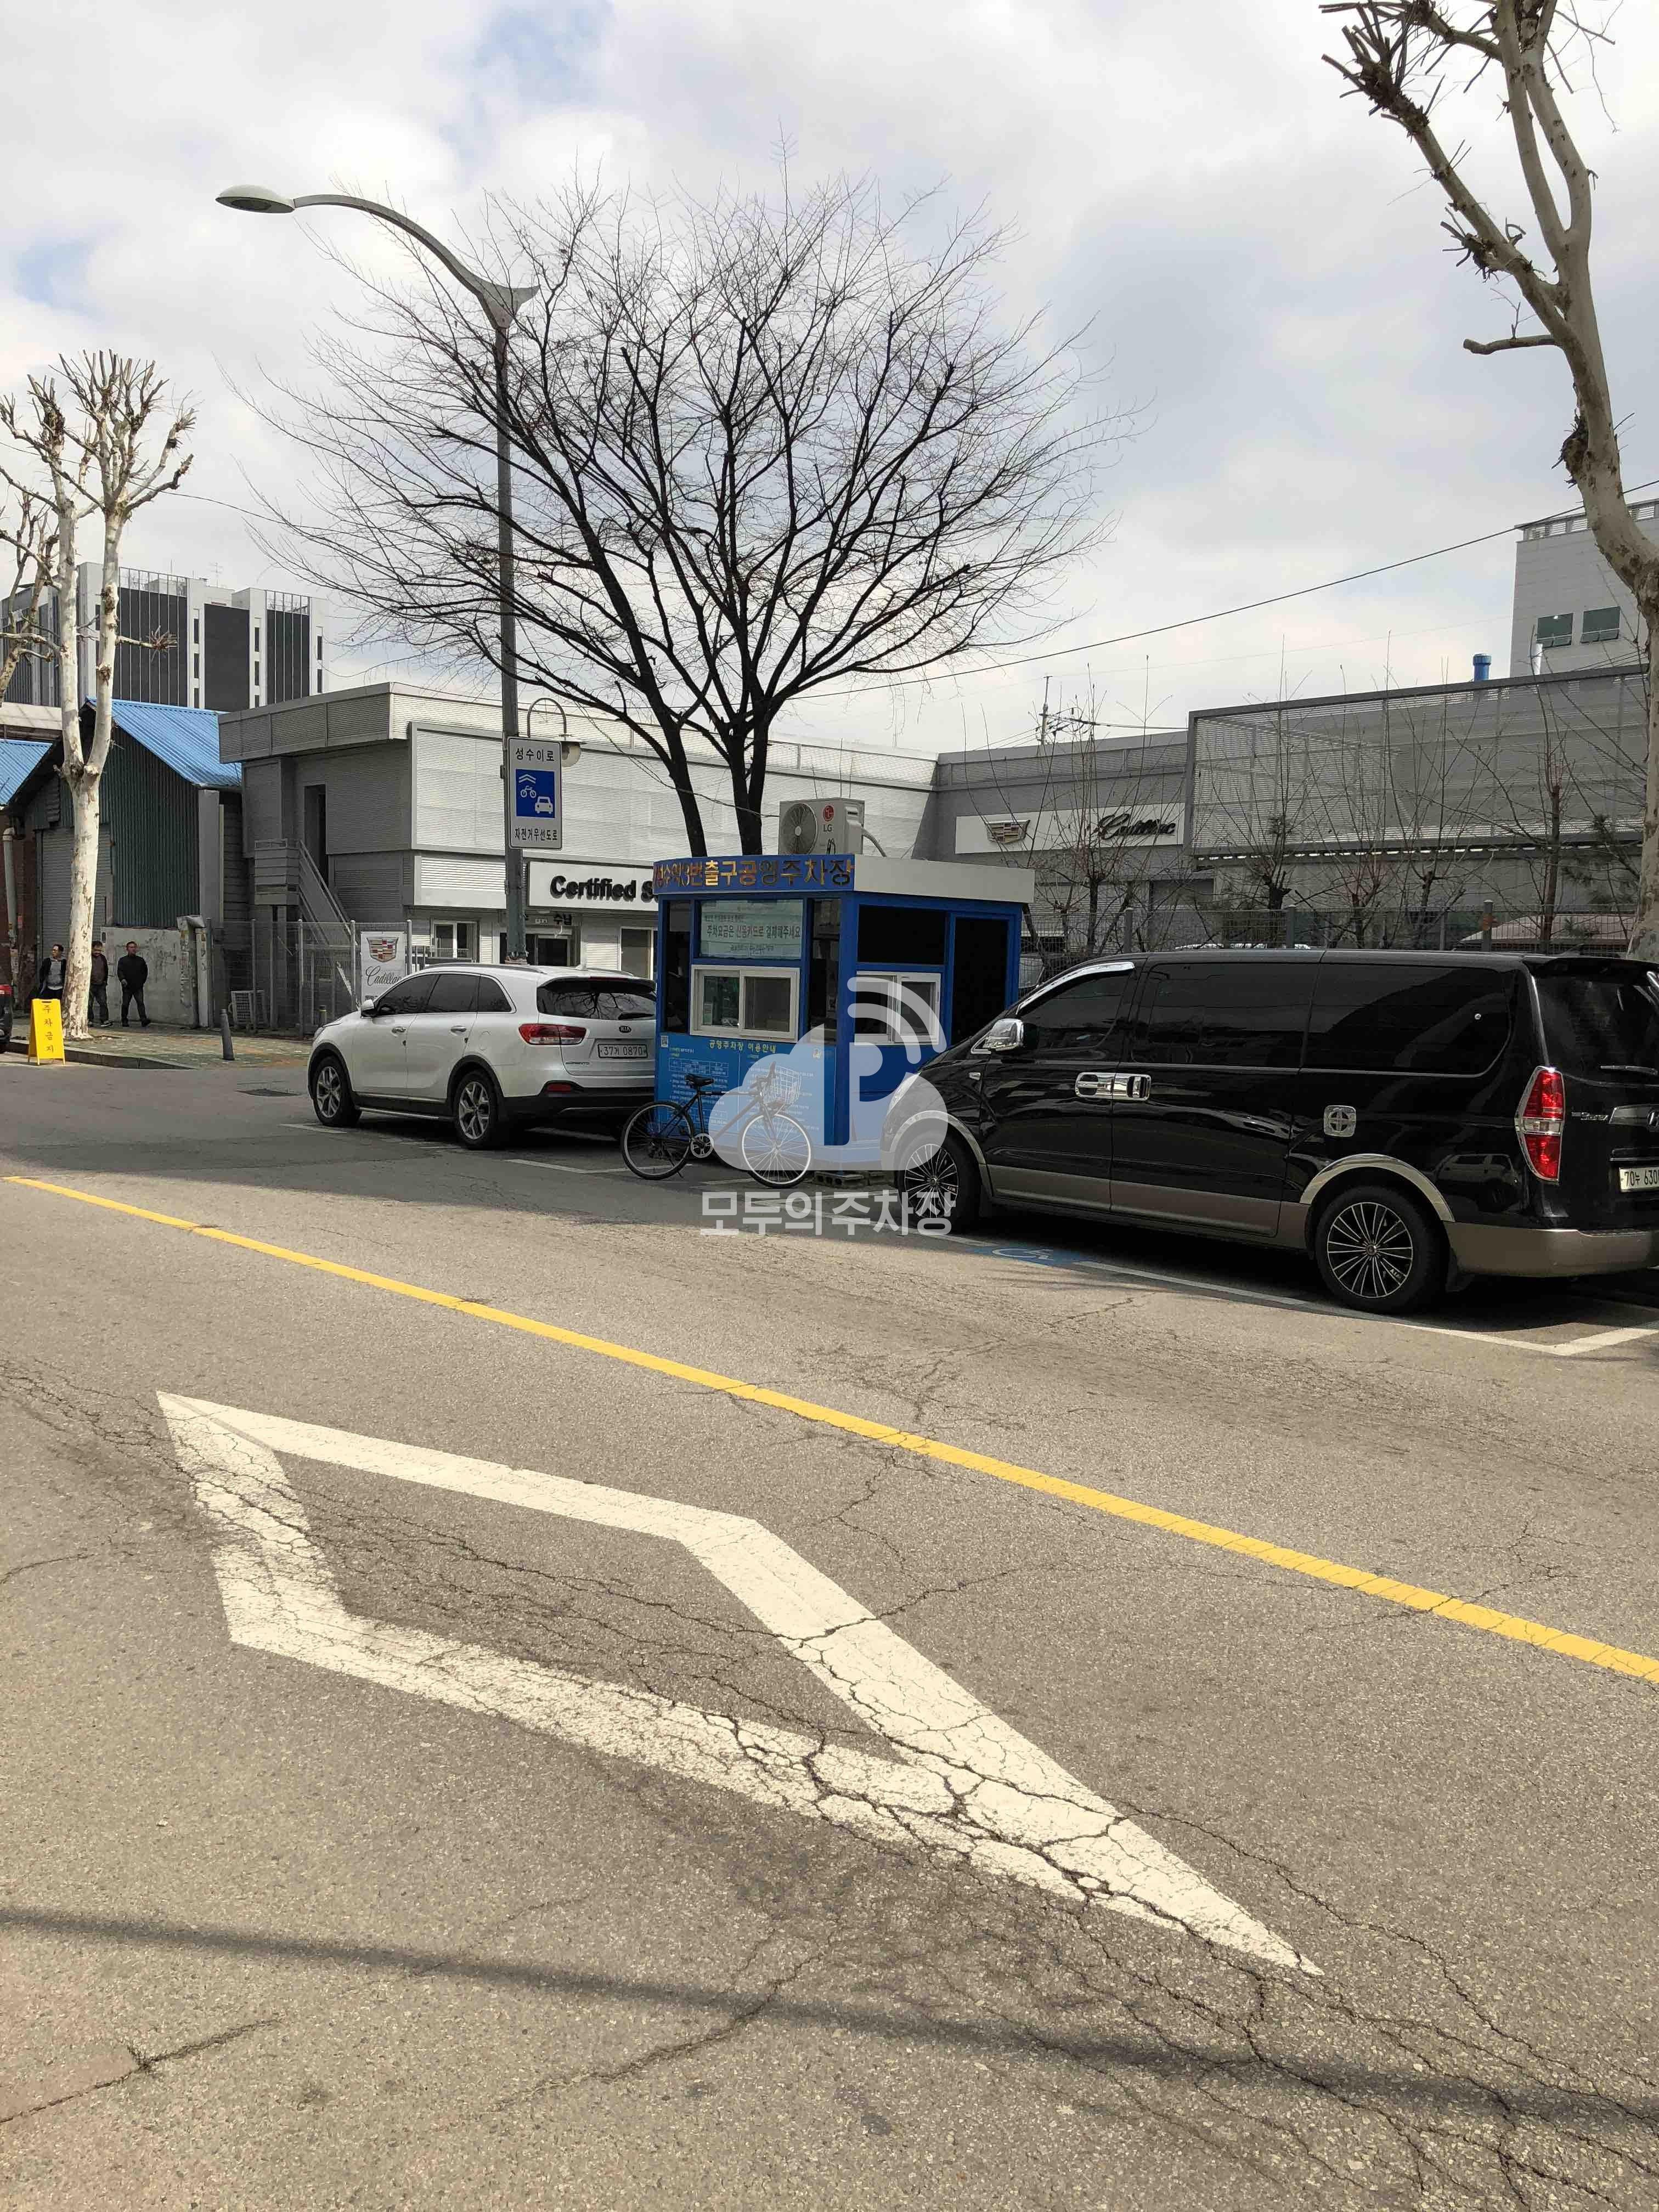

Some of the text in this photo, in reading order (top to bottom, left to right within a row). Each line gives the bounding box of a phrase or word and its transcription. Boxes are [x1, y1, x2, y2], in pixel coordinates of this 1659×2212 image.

[516, 748, 554, 761] 성수이로
[515, 828, 557, 841] 자전거우선도로
[550, 876, 636, 901] Certified
[1644, 1169, 1659, 1184] 630
